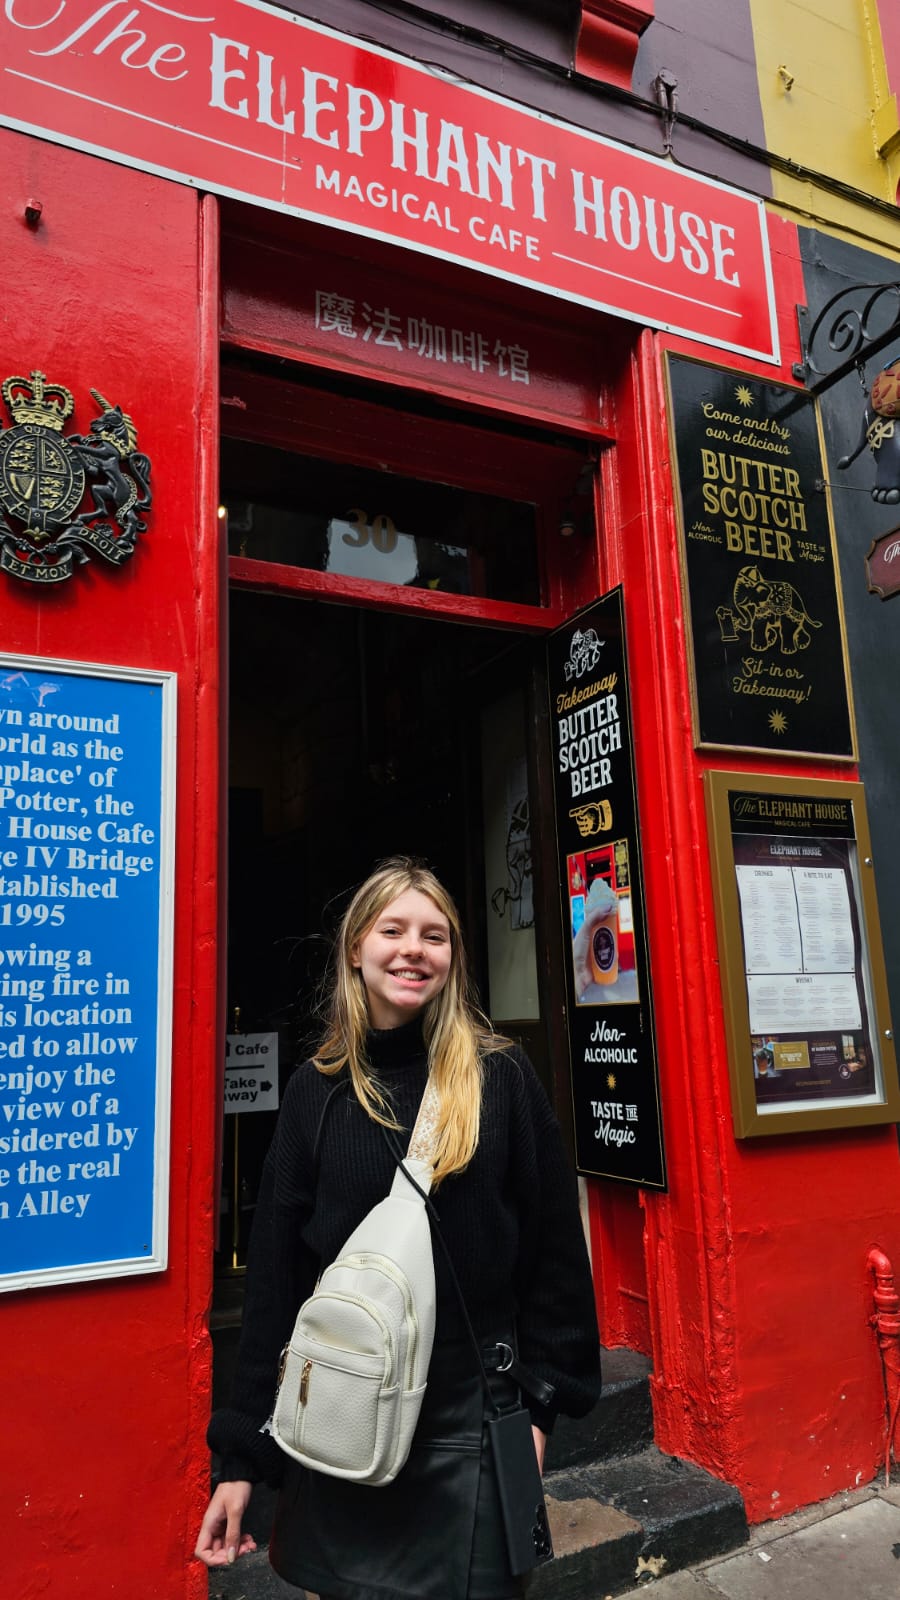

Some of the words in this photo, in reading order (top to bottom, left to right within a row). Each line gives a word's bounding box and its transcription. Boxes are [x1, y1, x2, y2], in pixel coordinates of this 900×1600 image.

[4, 0, 214, 81] The
[208, 33, 556, 223] ELEPHANT
[570, 169, 741, 287] HOUSE
[315, 165, 460, 233] MAGICAL
[469, 217, 540, 262] CAFE
[315, 290, 530, 385] 魔法咖啡馆
[701, 401, 742, 425] Come
[743, 418, 769, 432] and
[770, 420, 791, 440] try
[705, 427, 731, 441] our
[732, 430, 791, 455] delicious
[701, 448, 803, 499] BUTTER
[702, 483, 808, 532] SCOTCH
[342, 508, 398, 554] 30
[724, 520, 795, 562] BEER
[8, 560, 30, 574] ET
[36, 564, 68, 579] MON
[79, 526, 126, 560] DROIT
[797, 540, 817, 552] TASTE
[741, 657, 783, 678] Sit-in
[785, 667, 804, 679] or
[556, 672, 618, 714] Takeaway
[732, 676, 812, 704] Takeaway!
[28, 711, 120, 735] around
[558, 693, 620, 746] BUTTER
[52, 740, 78, 758] as
[84, 738, 123, 761] the
[559, 721, 622, 773] SCOTCH
[0, 760, 82, 787] place'
[89, 766, 117, 788] of
[570, 758, 613, 798] BEER
[0, 787, 88, 817] Potter,
[94, 793, 134, 817] the
[758, 799, 813, 819] ELEPHANT
[814, 804, 847, 820] HOUSE
[8, 815, 92, 842] House
[98, 820, 155, 844] Cafe
[24, 846, 60, 869] IV
[66, 847, 153, 877] Bridge
[1, 903, 65, 927] 1995
[76, 948, 92, 966] a
[51, 972, 100, 996] fire
[104, 972, 130, 995] in
[24, 1002, 132, 1027] location
[32, 1037, 59, 1057] to
[66, 1032, 138, 1055] allow
[590, 1020, 626, 1042] Non-
[235, 1043, 269, 1056] Cafe
[584, 1047, 638, 1063] ALCOHOLIC
[73, 1063, 116, 1086] the
[3, 1096, 64, 1122] view
[71, 1093, 102, 1117] of
[105, 1097, 119, 1115] a
[590, 1100, 624, 1120] TASTE
[626, 1105, 639, 1120] THE
[107, 1122, 138, 1150] by
[594, 1119, 636, 1148] Magic
[17, 1159, 61, 1185] the
[67, 1153, 120, 1181] real
[16, 1190, 91, 1219] Alley
